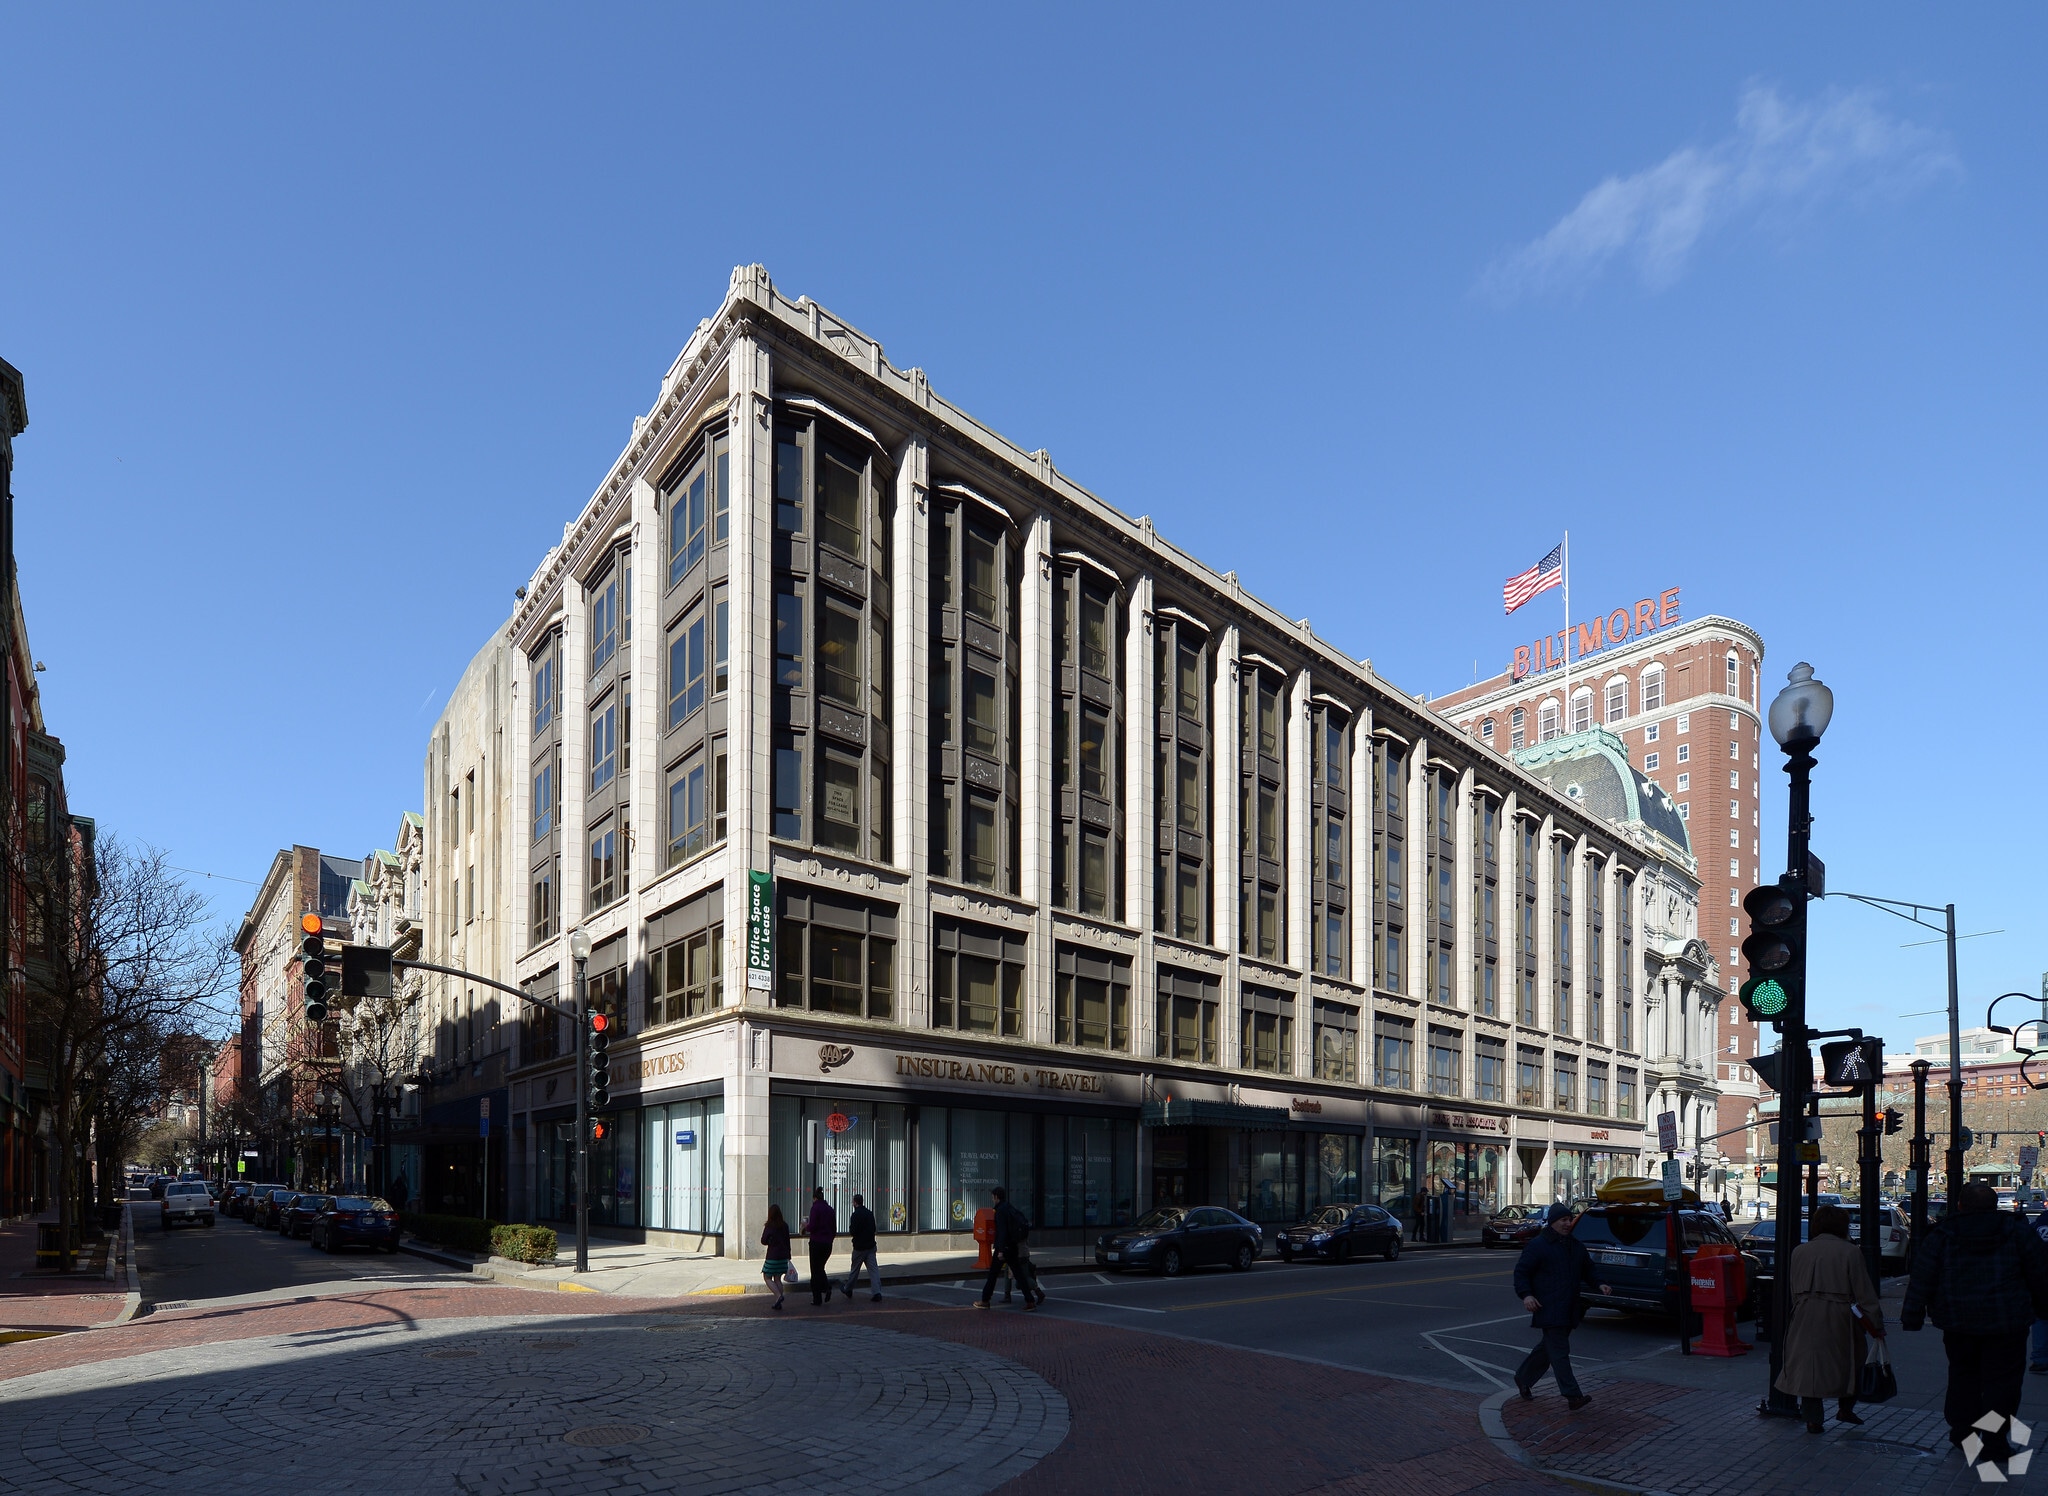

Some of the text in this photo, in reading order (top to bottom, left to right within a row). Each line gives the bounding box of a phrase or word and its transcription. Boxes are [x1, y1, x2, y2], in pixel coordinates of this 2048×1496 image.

[1513, 586, 1680, 680] BILTMORE
[751, 884, 762, 922] Space
[751, 927, 760, 966] Office
[761, 905, 770, 968] For Lease
[629, 1050, 686, 1080] SERVICES
[895, 1054, 1101, 1093] INSURANCE TRAVEL
[1663, 1114, 1671, 1123] NO
